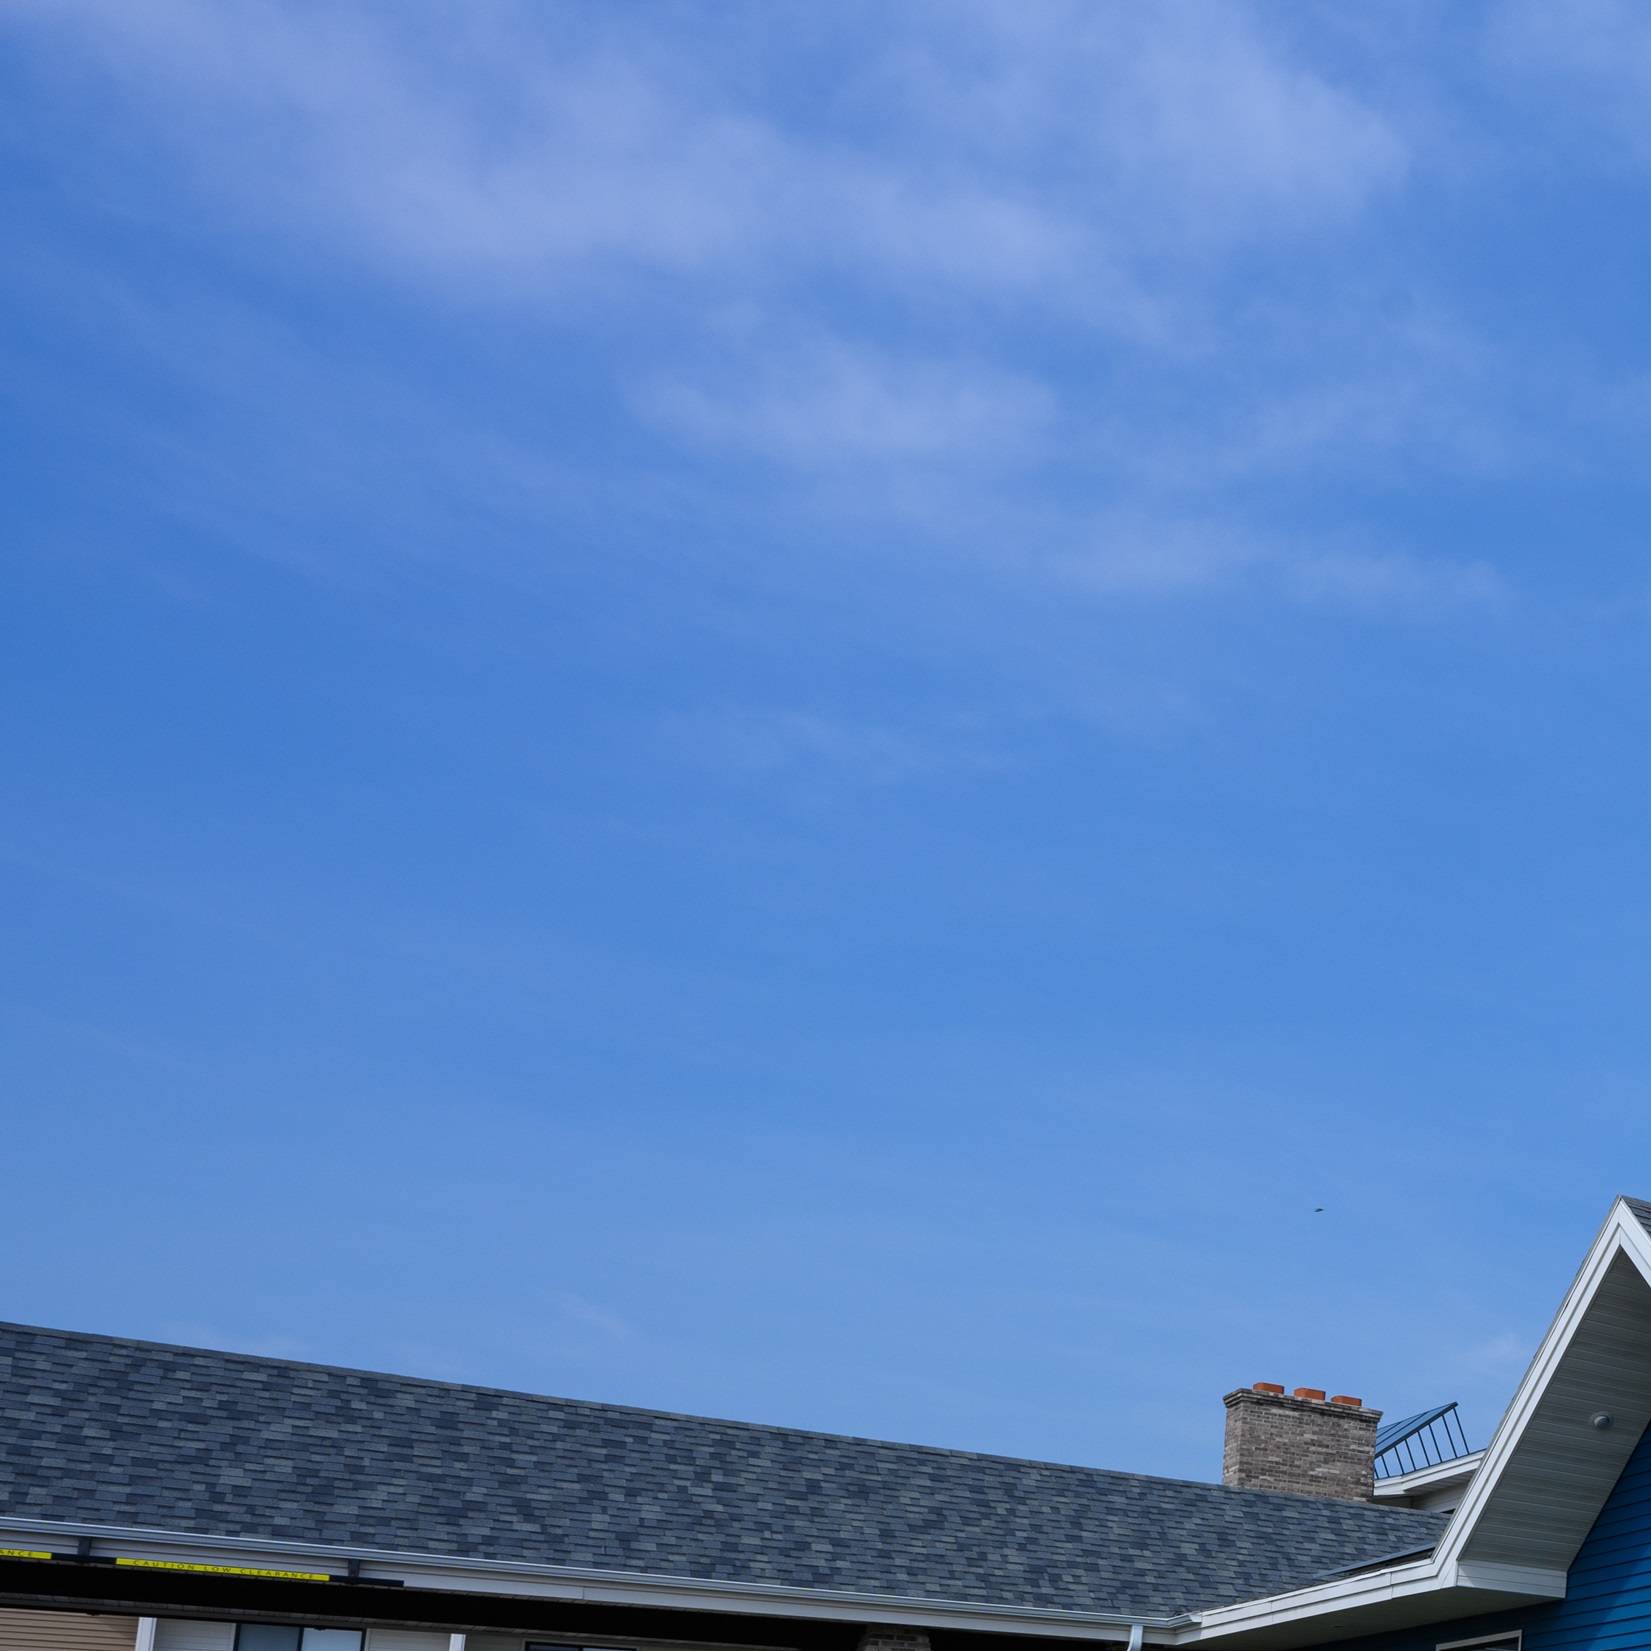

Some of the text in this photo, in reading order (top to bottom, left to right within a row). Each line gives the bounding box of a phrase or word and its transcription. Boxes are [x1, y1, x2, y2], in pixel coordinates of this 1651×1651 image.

[0, 1549, 33, 1558] ANCE
[133, 1560, 195, 1570] CAUTION
[240, 1568, 314, 1580] CLEARANCE
